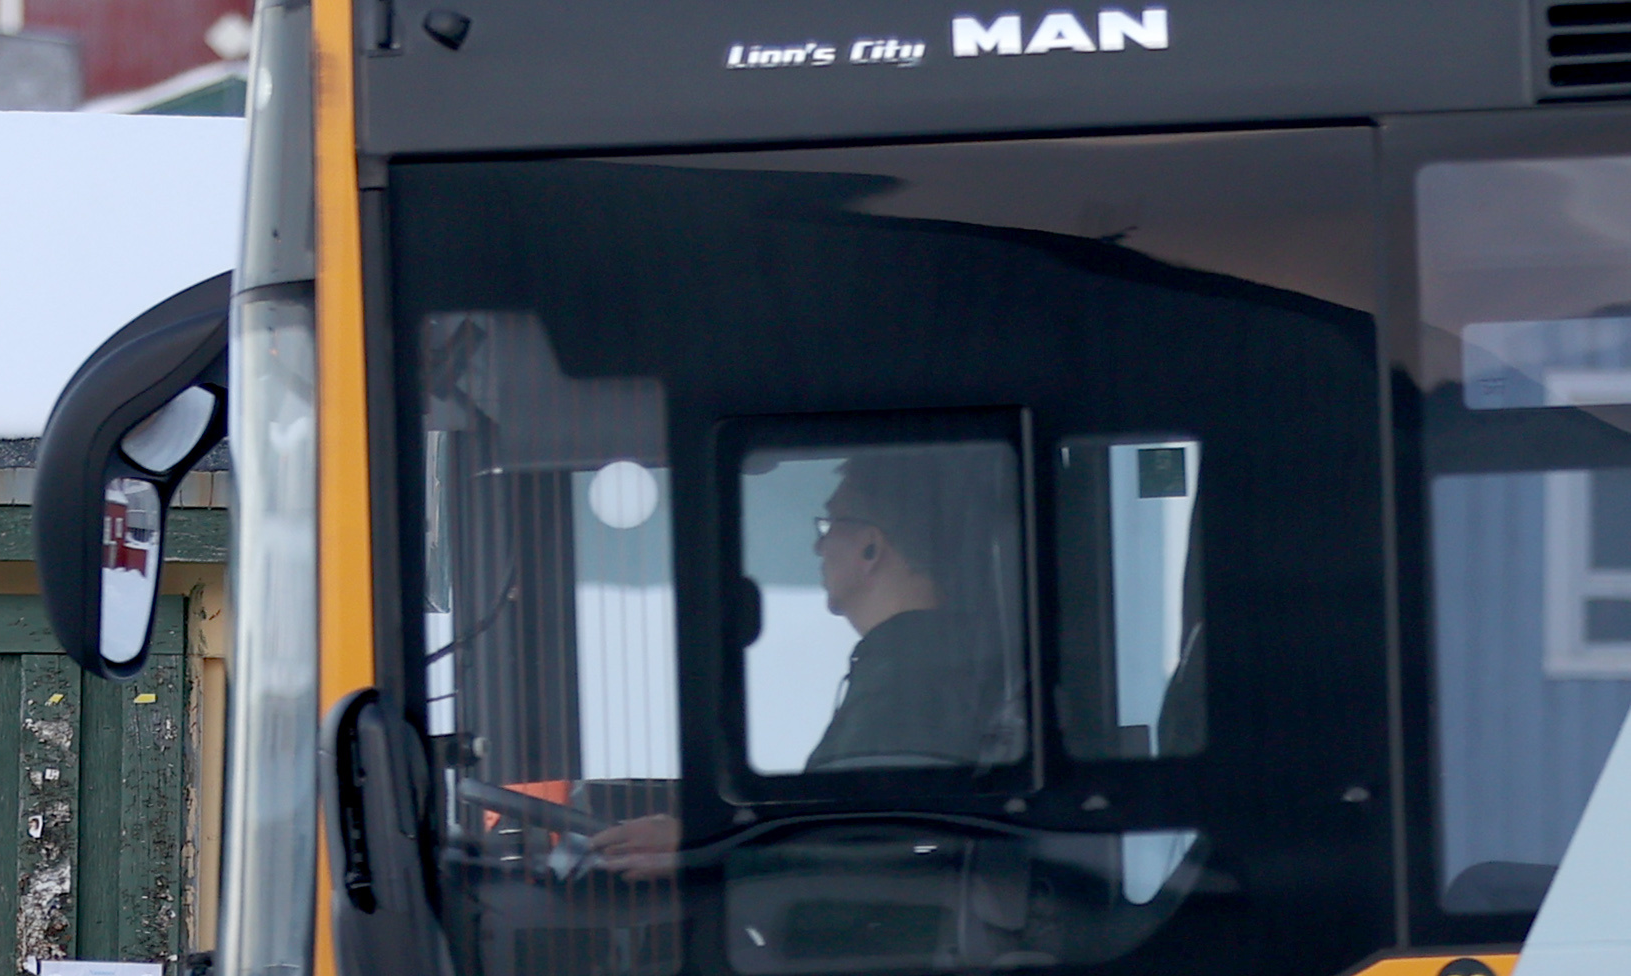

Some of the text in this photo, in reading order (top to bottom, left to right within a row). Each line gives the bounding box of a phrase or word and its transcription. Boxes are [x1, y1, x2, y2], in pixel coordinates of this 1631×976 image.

[725, 8, 1168, 69] Lion's City MAN
